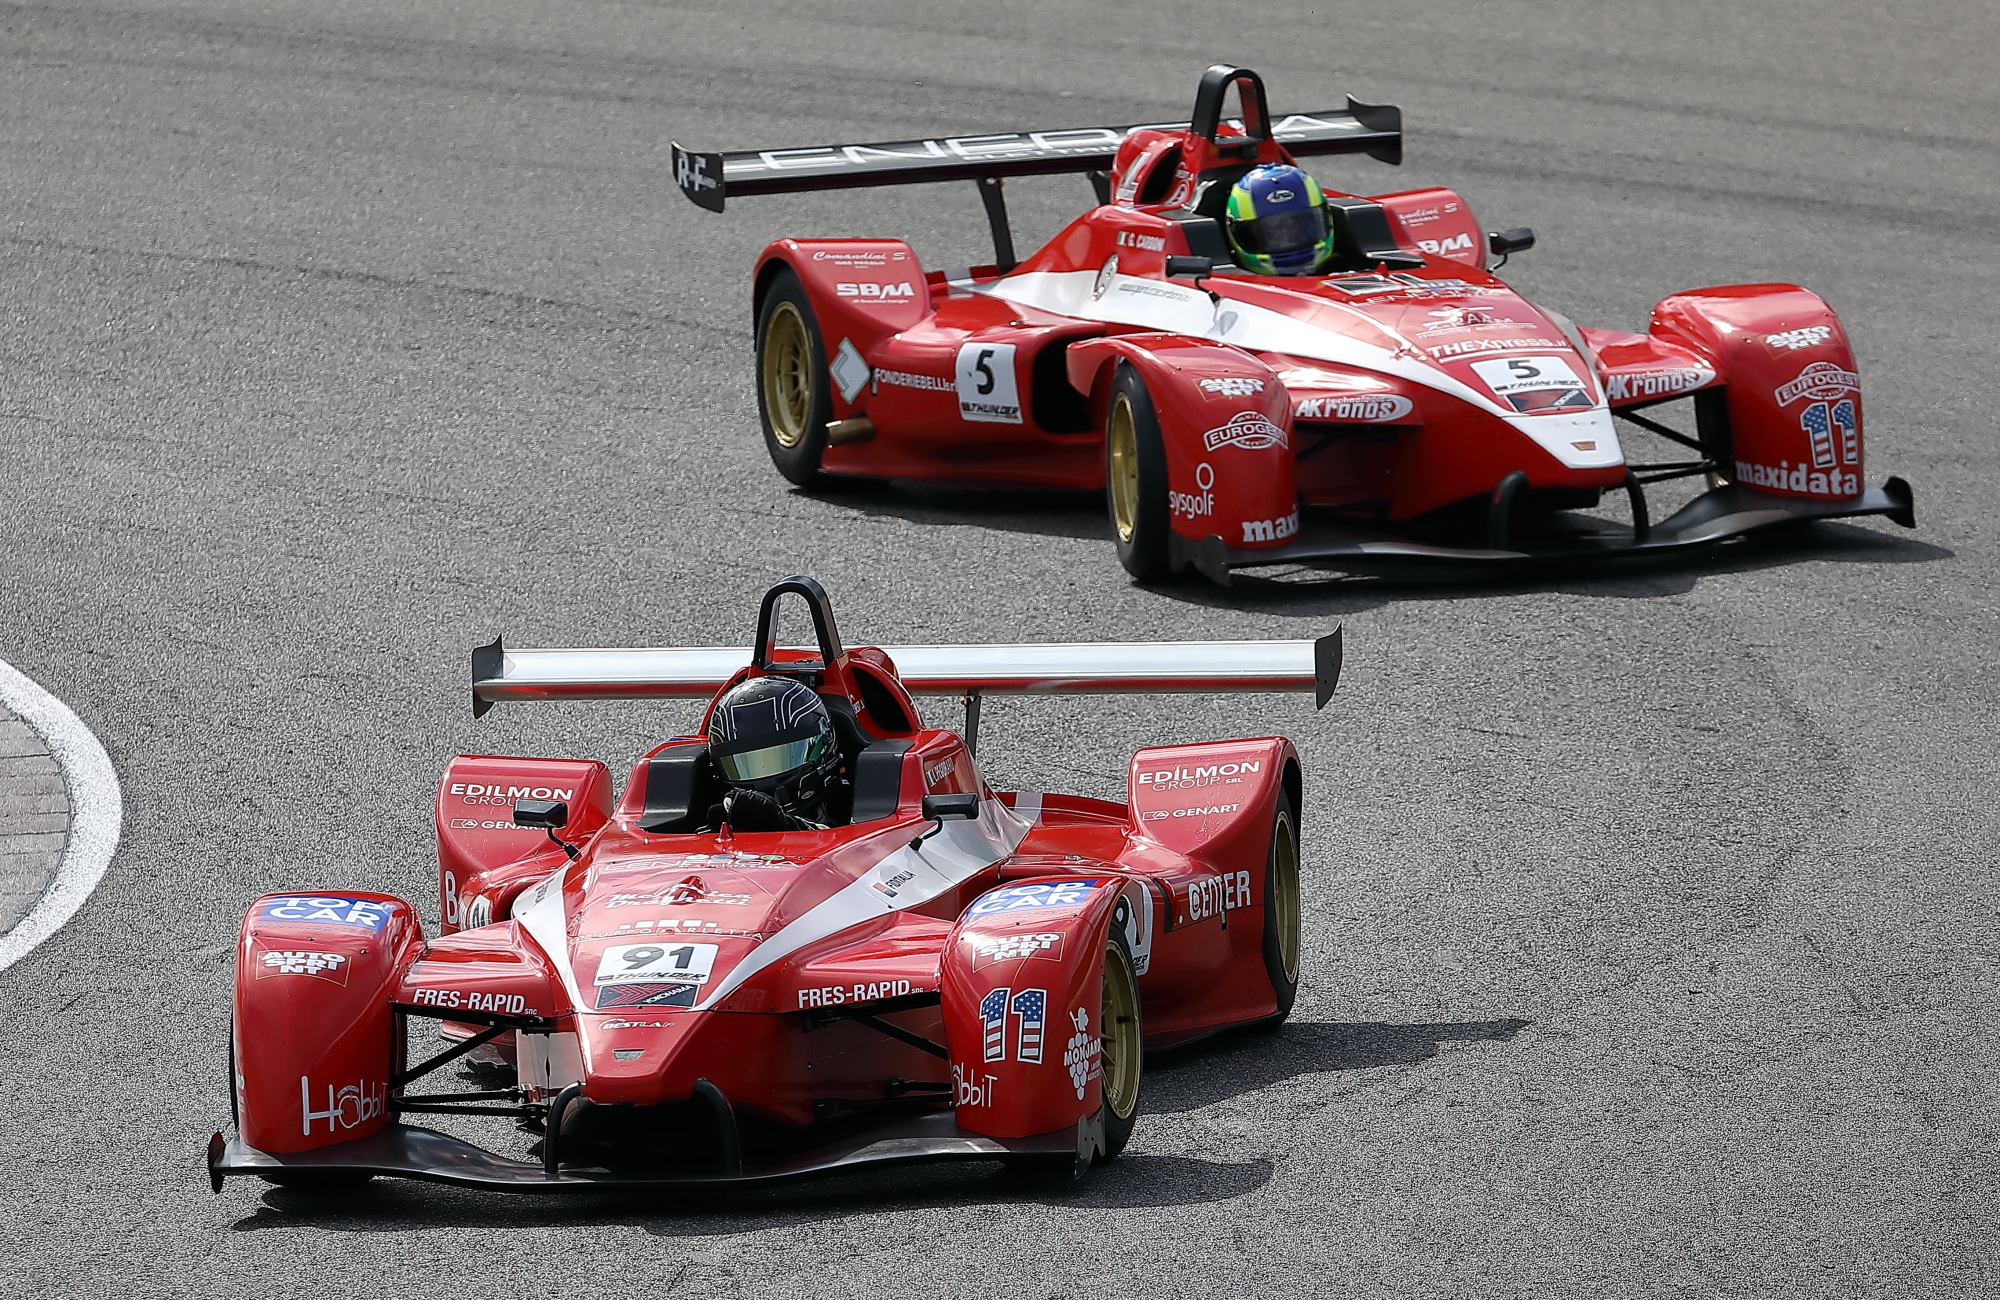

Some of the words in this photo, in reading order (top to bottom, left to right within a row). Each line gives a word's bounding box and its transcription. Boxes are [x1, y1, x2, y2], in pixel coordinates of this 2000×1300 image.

[1415, 232, 1475, 256] BM
[813, 250, 887, 261] Comandini
[836, 282, 915, 299] SBM
[974, 348, 996, 396] 5
[1508, 359, 1541, 380] 5
[1782, 374, 1859, 400] EUROGEST
[971, 403, 1019, 415] THUNDER
[1800, 399, 1858, 469] 11
[1735, 460, 1859, 496] maxidata
[1168, 489, 1215, 520] sysgolf
[1138, 760, 1261, 785] EDILMON
[450, 783, 574, 801] EDILMON
[1151, 776, 1221, 792] GROUP
[1225, 777, 1244, 785] SRL
[462, 796, 516, 807] GROU
[1172, 802, 1240, 818] GENART
[984, 881, 1087, 901] TOP
[280, 897, 384, 911] TOP
[971, 890, 1082, 914] CAR
[269, 906, 381, 927] CAR
[983, 932, 1061, 947] AUTO
[260, 950, 347, 963] AUTO
[264, 957, 338, 971] SPRI
[622, 946, 696, 971] 91
[279, 964, 322, 975] NT
[615, 971, 708, 980] THUNDER
[412, 988, 526, 1015] FRES-RAPID
[642, 985, 696, 1004] YOKOHAMA
[798, 979, 911, 1009] FRES-RAPID
[979, 987, 1048, 1065] 11
